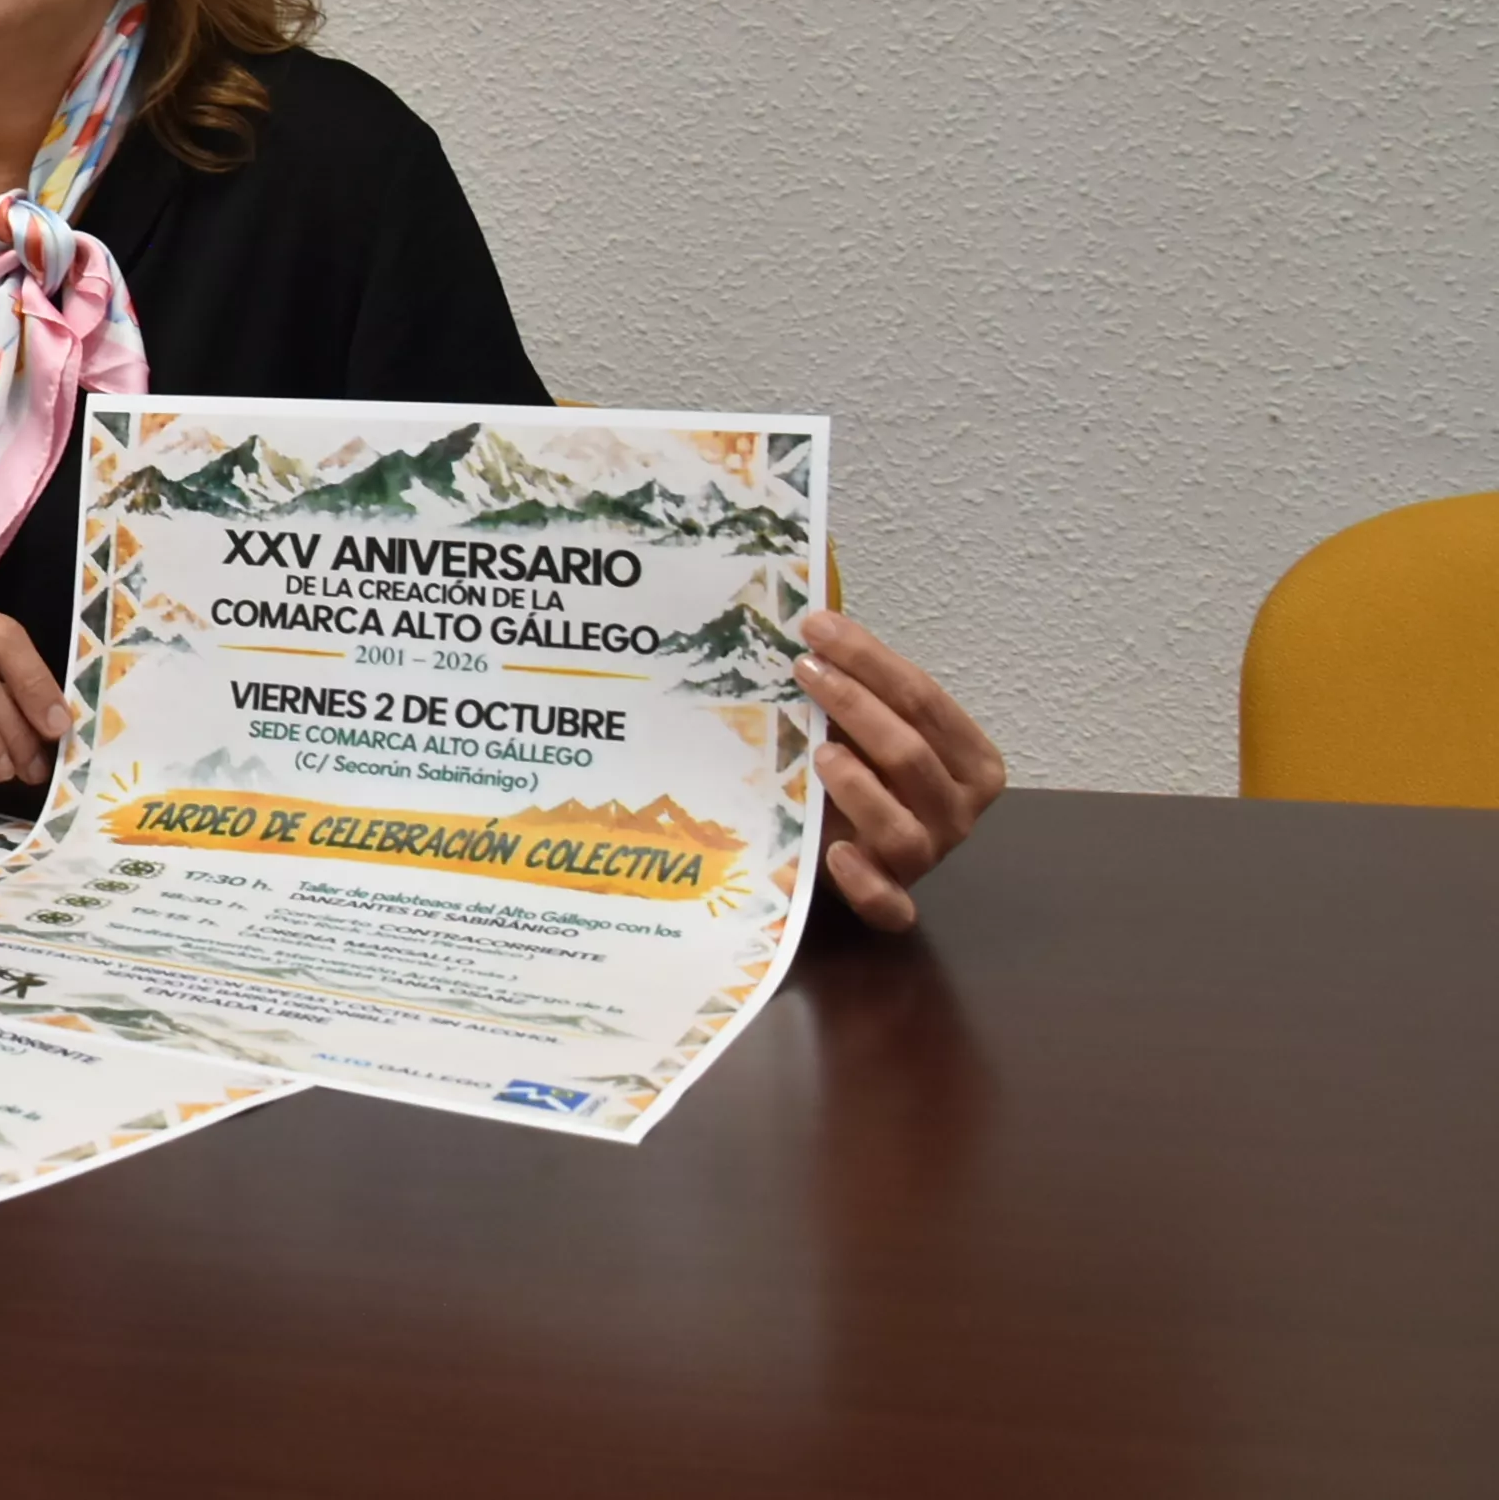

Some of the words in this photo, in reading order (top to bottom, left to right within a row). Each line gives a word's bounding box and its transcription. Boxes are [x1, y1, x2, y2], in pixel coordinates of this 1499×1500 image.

[223, 529, 321, 568] XXV
[331, 536, 641, 587] ANIVERSARIO
[286, 575, 316, 596] DE
[322, 577, 352, 597] LA
[358, 580, 486, 606] CREACIÓN
[492, 587, 525, 608] DE
[532, 590, 564, 611] LA
[211, 599, 384, 636] COMARCA
[392, 612, 481, 642] ALTO
[490, 613, 659, 655] GÁLLEGO
[355, 645, 404, 666] 2001
[433, 651, 488, 673] 2026
[231, 680, 367, 720] VIERNES
[374, 695, 394, 722] 2
[402, 696, 447, 725] DE
[455, 700, 626, 741] OCTUBRE
[249, 720, 300, 741] SEDE
[305, 726, 417, 753] COMARCA
[423, 736, 479, 756] ALTO
[486, 738, 592, 767] GÁLLEGO
[295, 752, 328, 774] (C/
[333, 755, 411, 778] Secorún
[135, 801, 257, 838] TARDEO
[260, 810, 306, 843] DE
[309, 816, 521, 865] CELEBRACIÓN
[525, 839, 703, 887] COLECTIVA
[182, 869, 247, 887] 17:30
[252, 878, 273, 892] h.
[289, 893, 407, 917] DANZANTES
[412, 907, 440, 920] DE
[444, 911, 579, 938] SABIÑÁNIGO
[298, 880, 343, 897] Taller
[345, 887, 369, 898] de
[466, 900, 495, 914] del
[499, 904, 537, 919] Alto
[541, 909, 611, 931] Gállego
[616, 922, 651, 934] con
[654, 924, 683, 938] los
[245, 924, 337, 946] LORENA
[342, 938, 474, 965] MARGALLO
[378, 923, 606, 961] CONTRACORRIENTE
[142, 987, 266, 1012] ENTRADA
[268, 1004, 331, 1025] LIBRE
